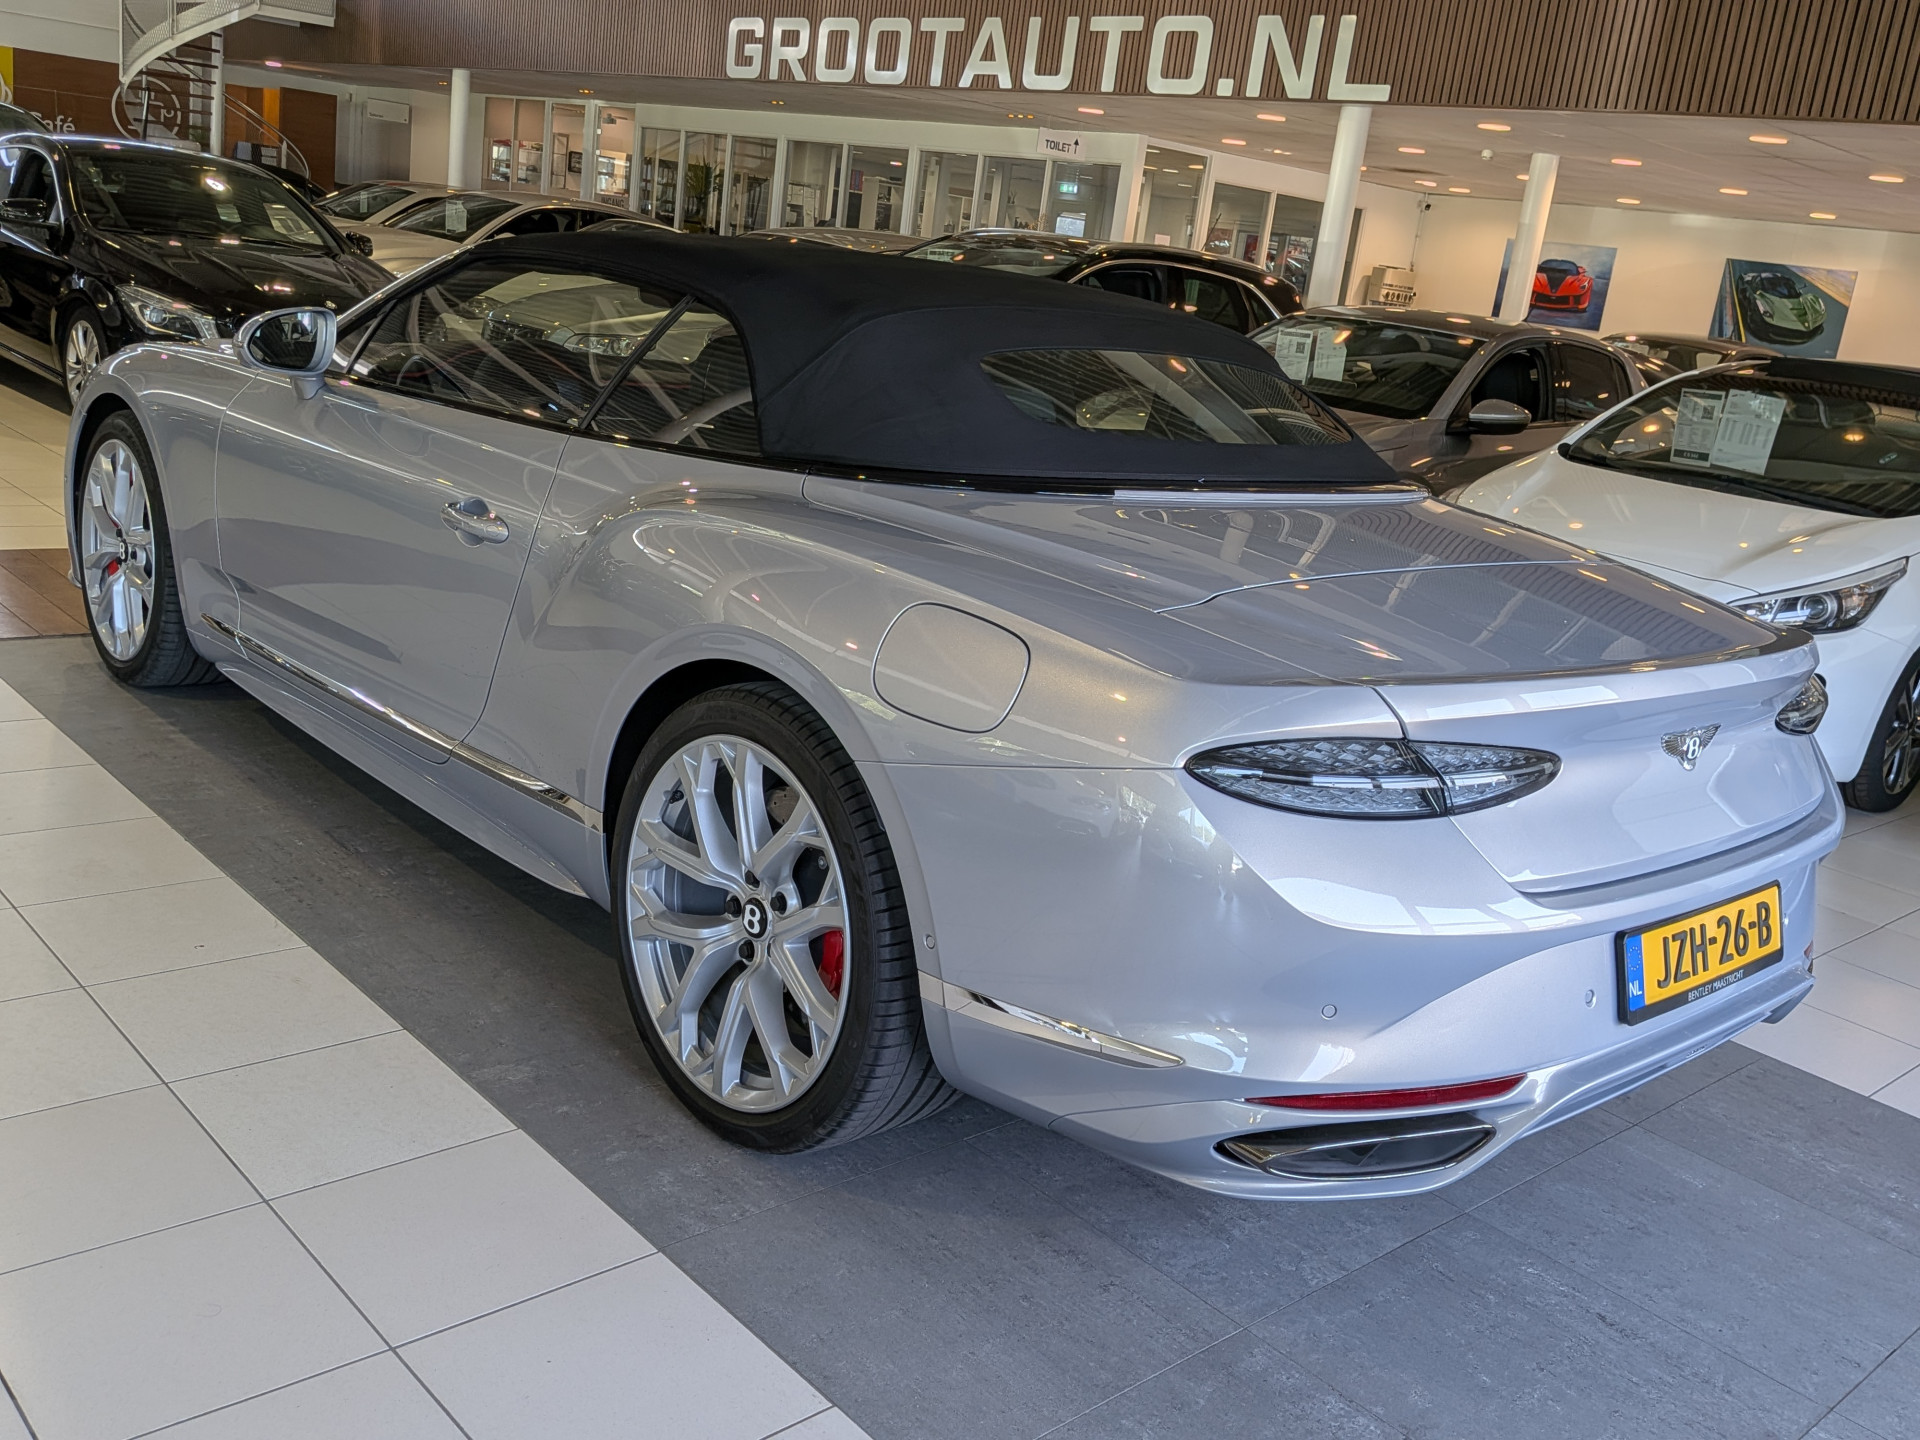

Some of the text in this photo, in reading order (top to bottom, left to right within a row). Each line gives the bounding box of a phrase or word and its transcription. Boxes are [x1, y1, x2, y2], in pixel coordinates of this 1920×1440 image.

[726, 14, 1391, 102] GROOTAUTO.NL
[1045, 139, 1071, 153] TOILET
[743, 904, 761, 934] B
[1657, 901, 1772, 989] JZH-26-B
[1629, 980, 1643, 998] NL
[1688, 969, 1744, 1001] BENTLEY MAASTRICHT
